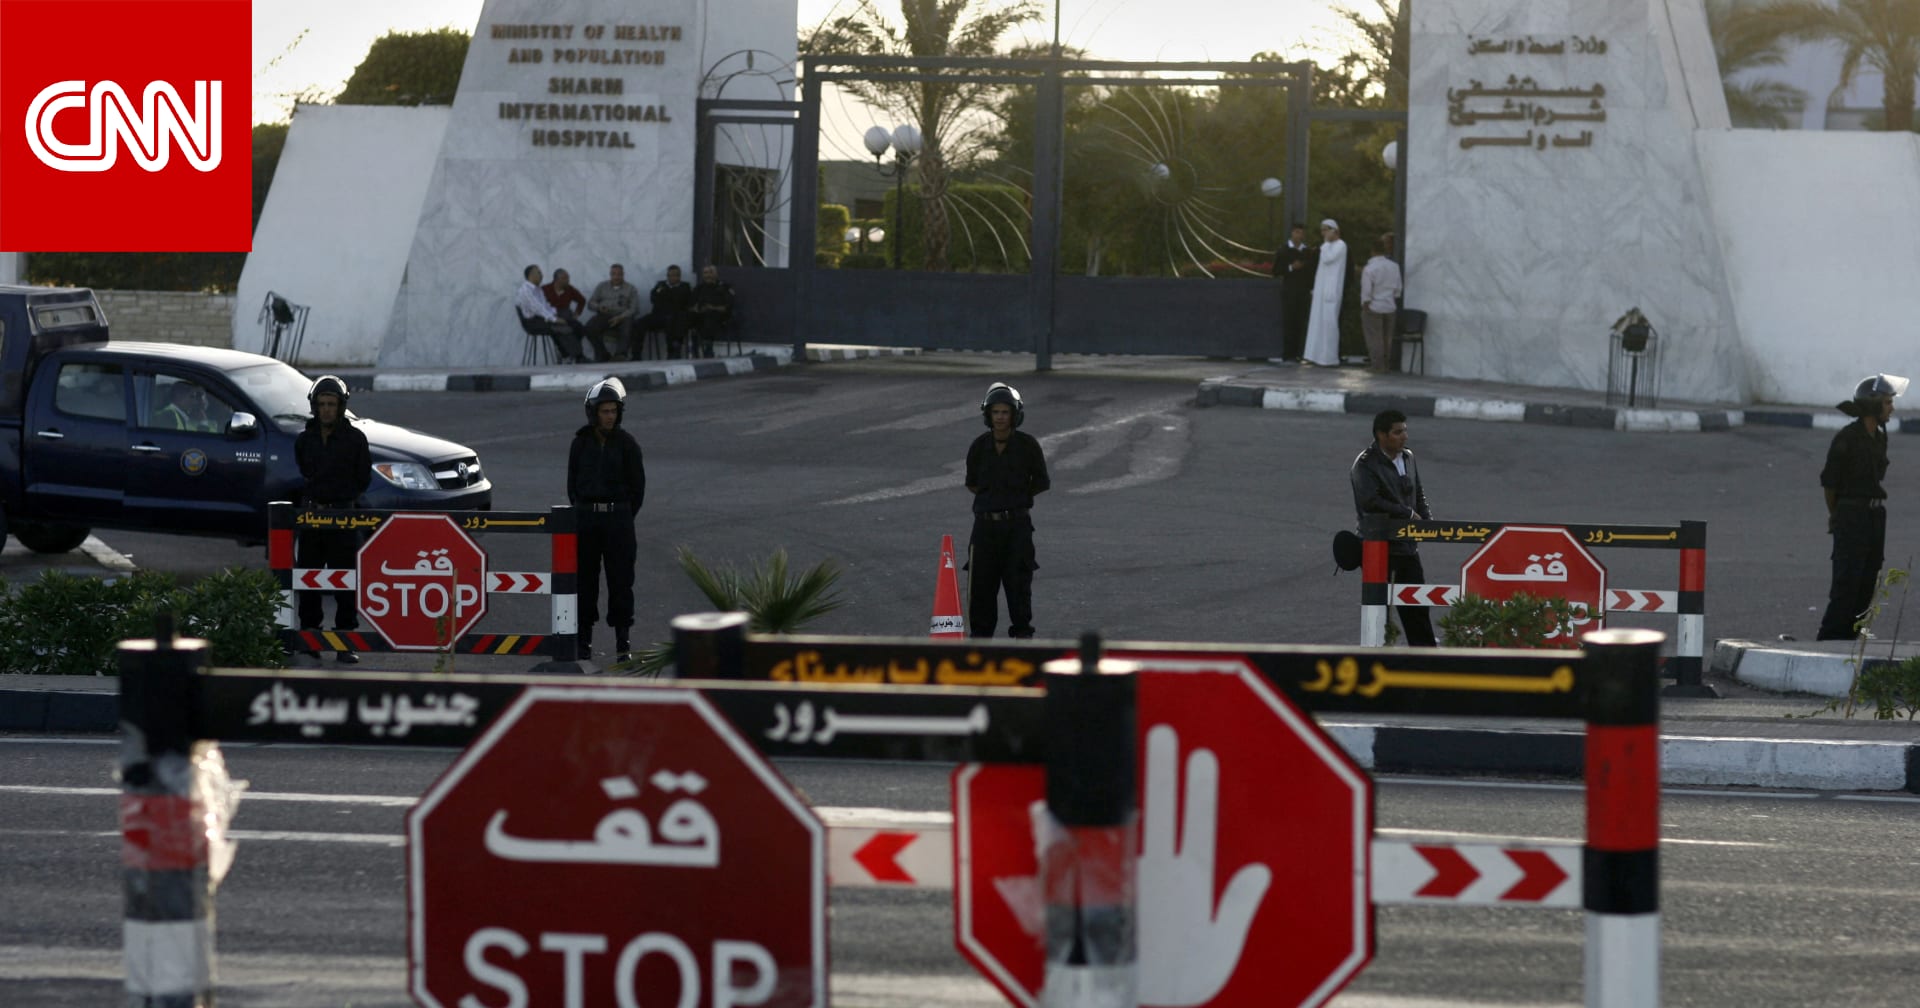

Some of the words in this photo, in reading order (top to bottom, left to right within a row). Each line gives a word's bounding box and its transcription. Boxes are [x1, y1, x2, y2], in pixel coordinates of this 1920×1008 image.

[491, 24, 574, 40] MINISTRY
[584, 25, 605, 40] OF
[615, 25, 682, 41] HEALTH
[508, 48, 543, 64] AND
[553, 49, 666, 65] POPULATION
[548, 77, 624, 95] SHARM
[498, 102, 672, 123] INTERNATIONAL
[532, 129, 635, 149] HOSPITAL
[296, 512, 333, 526] سيناء
[336, 515, 382, 530] جنوب
[463, 515, 545, 528] مرور
[1396, 524, 1438, 541] سيناء
[1440, 525, 1492, 541] جنوب
[1585, 530, 1677, 543] مرور
[380, 548, 454, 577] قف
[1486, 552, 1568, 583] قف
[366, 582, 479, 618] STOP
[1302, 656, 1575, 697] مرور
[246, 681, 350, 737] سيناء
[356, 691, 479, 737] جنوب
[765, 700, 990, 745] مرور
[484, 769, 720, 867] قف
[458, 926, 779, 1008] STOP
